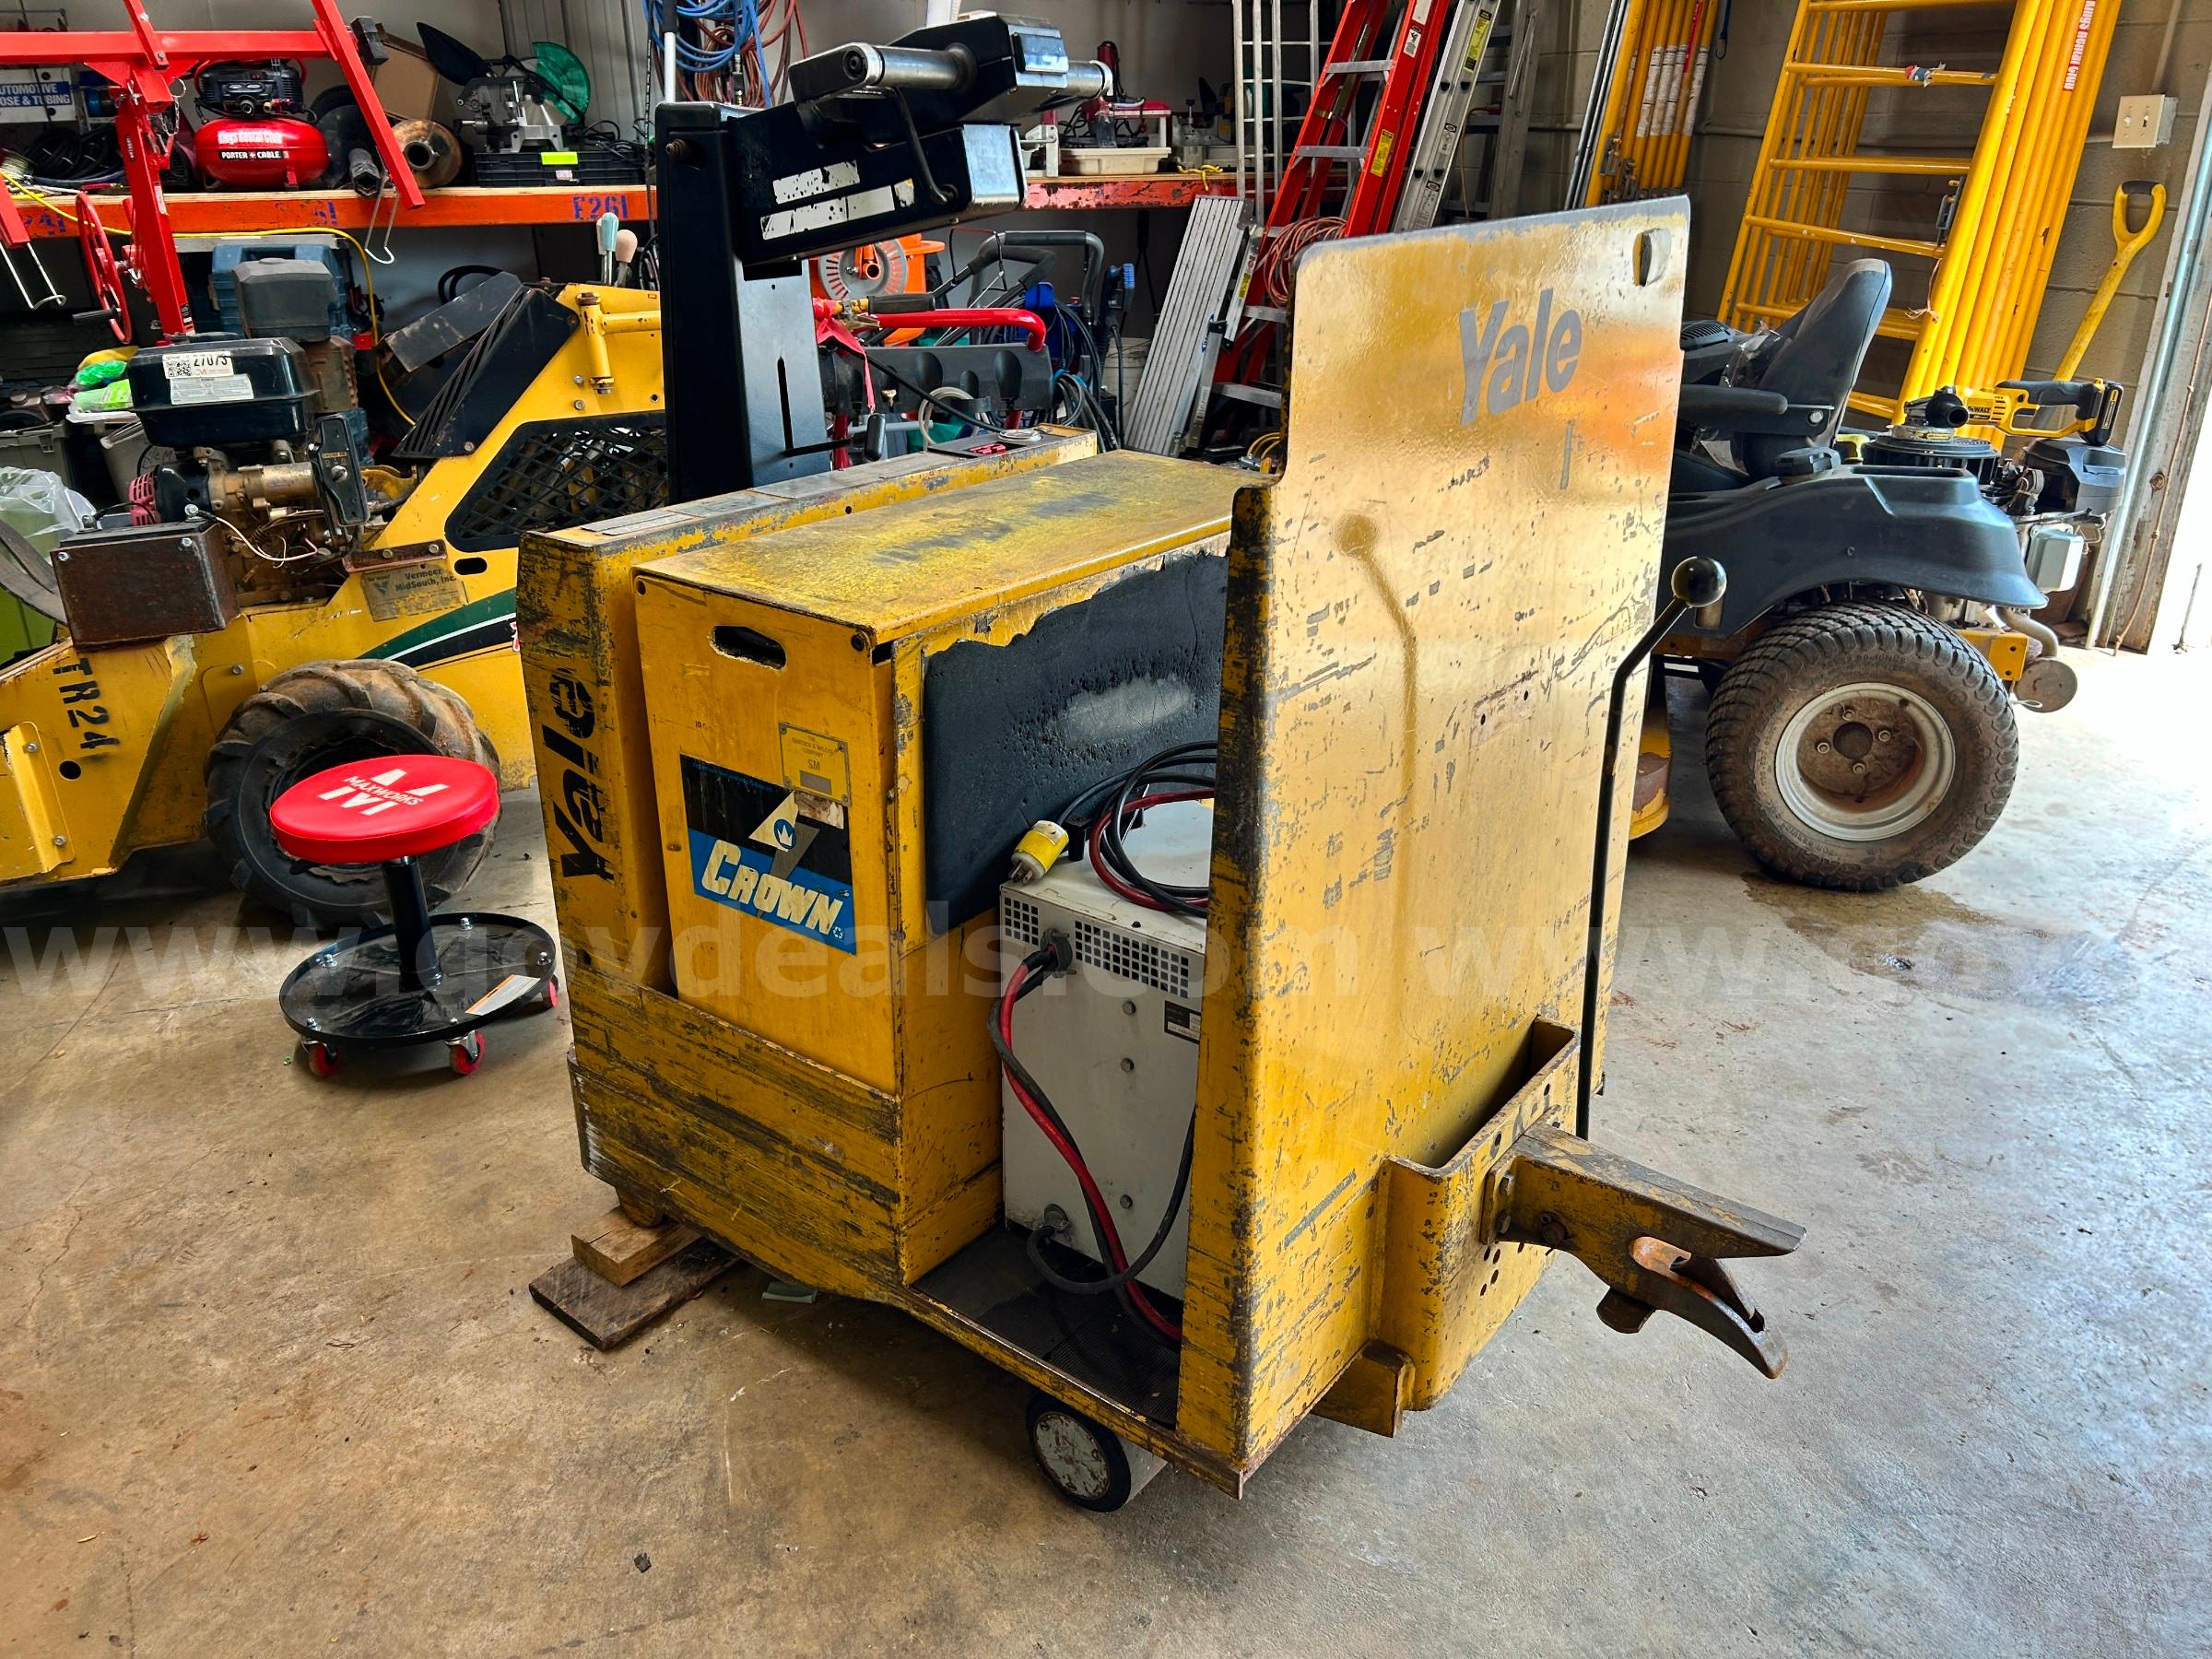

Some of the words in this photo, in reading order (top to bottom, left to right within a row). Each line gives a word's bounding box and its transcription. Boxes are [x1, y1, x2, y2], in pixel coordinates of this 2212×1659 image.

[1459, 288, 1583, 427] Yale
[395, 576, 440, 591] MidSouth,
[441, 574, 457, 584] Inc.
[405, 567, 442, 581] Vermeer
[53, 657, 121, 749] TR24
[343, 775, 424, 806] MAXWORKS
[542, 667, 615, 882] Yale
[701, 839, 844, 935] CROWN
